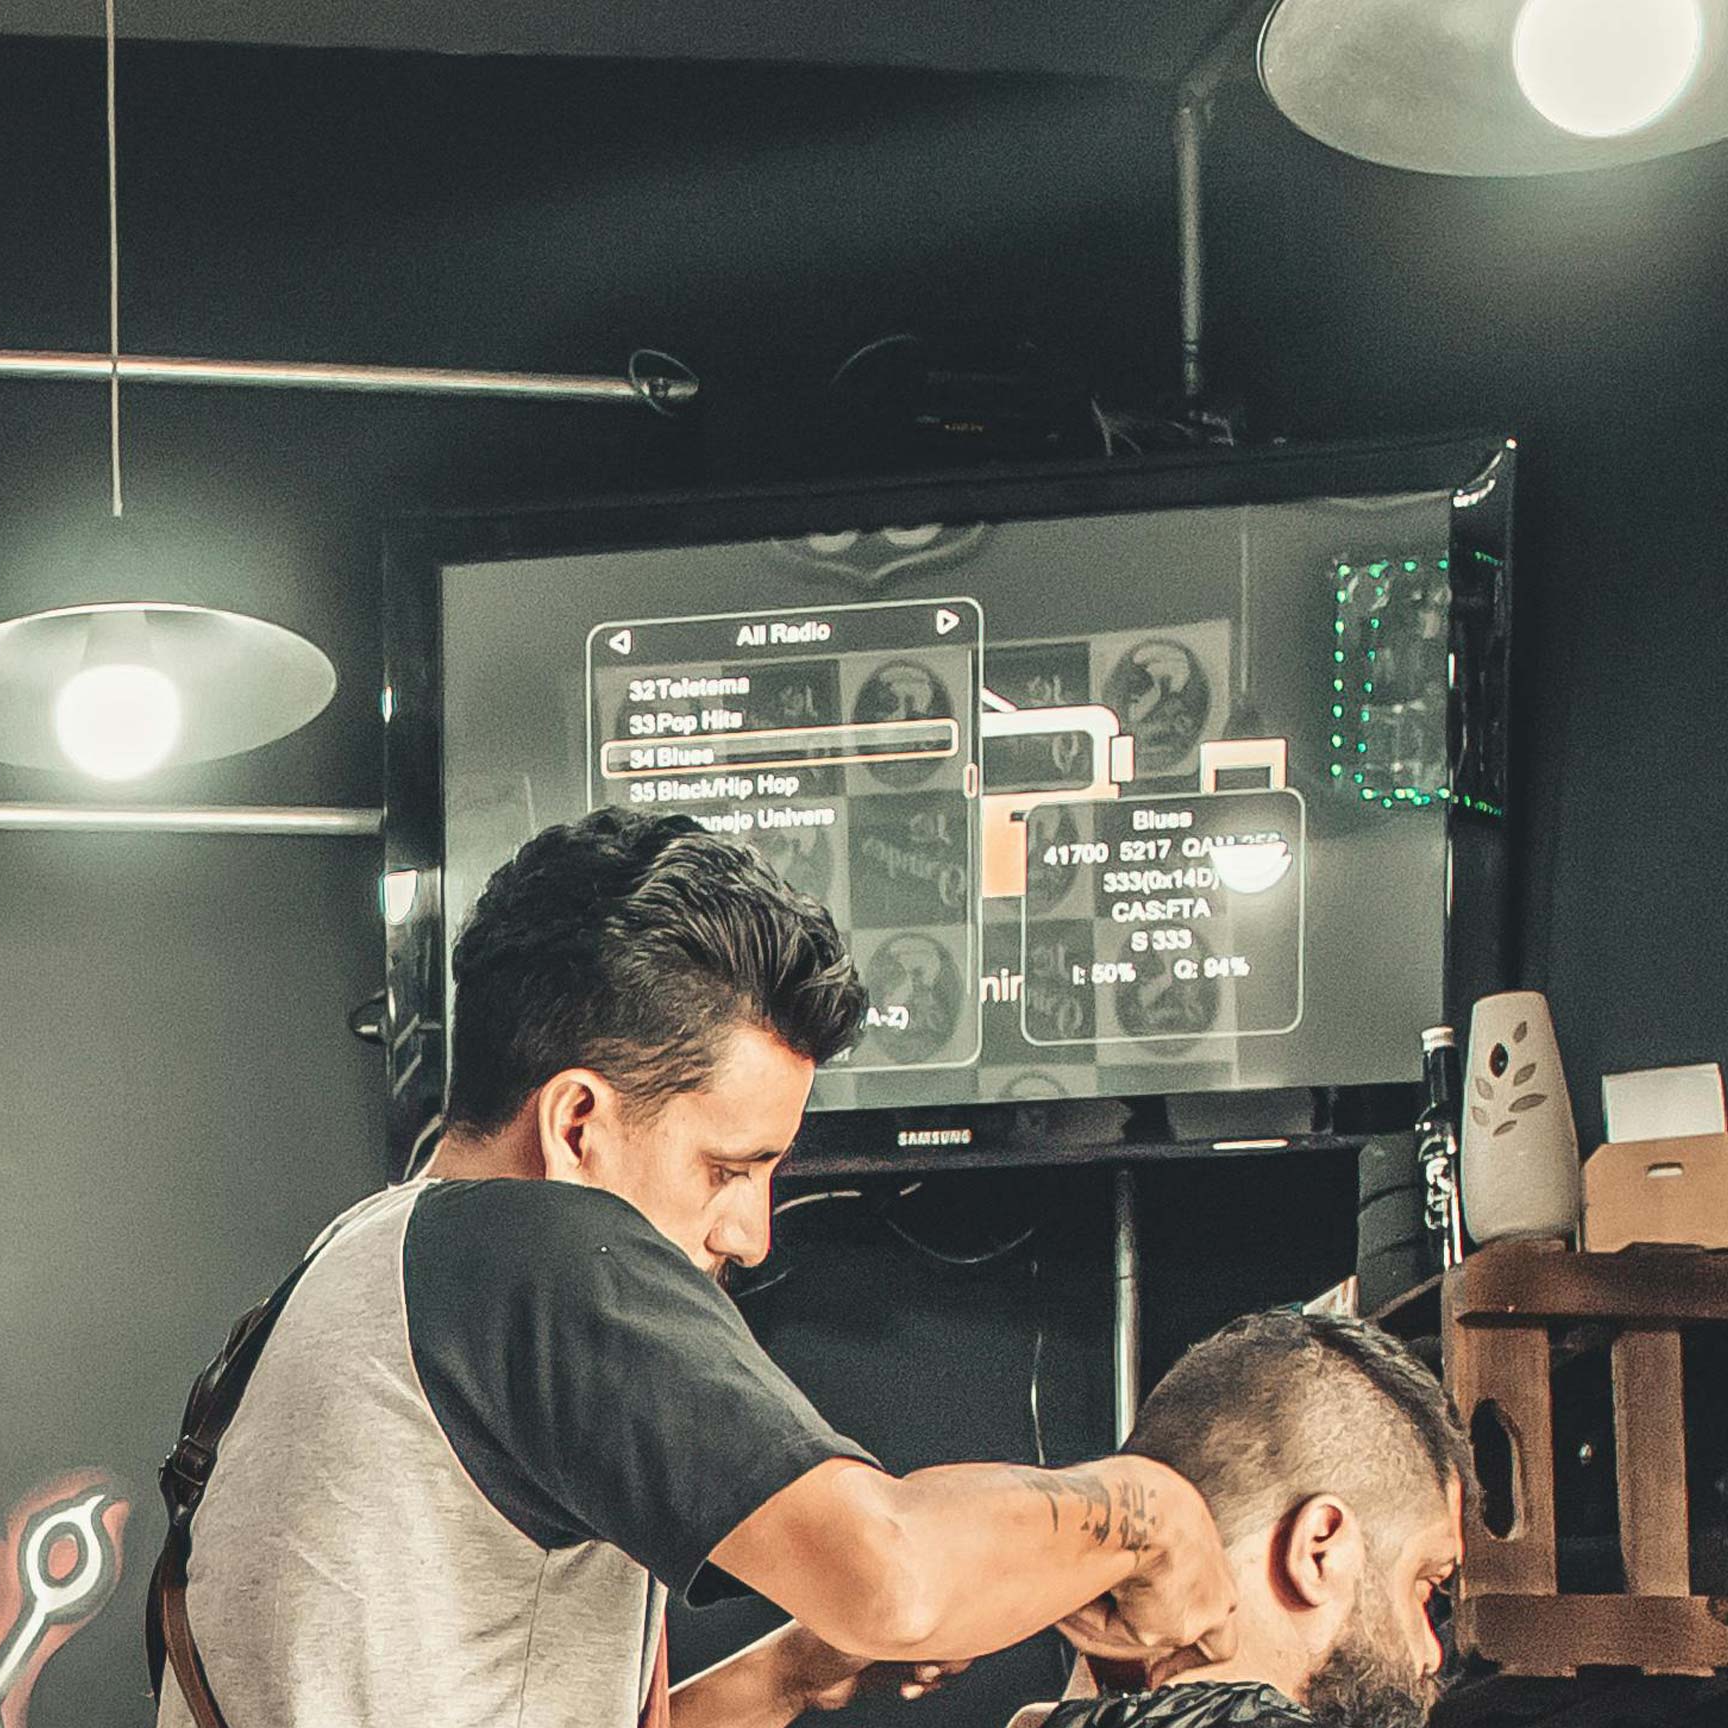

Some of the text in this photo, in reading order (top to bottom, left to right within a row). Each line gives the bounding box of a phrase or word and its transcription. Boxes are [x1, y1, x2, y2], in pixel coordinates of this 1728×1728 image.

[736, 621, 832, 646] All Radio
[629, 680, 656, 701] 32
[629, 709, 743, 735] 33 Pop Hits
[629, 747, 714, 769] 34 Blues
[630, 774, 800, 803] 35 Black/Hip Hop
[691, 808, 835, 834] anejo Univers
[1133, 810, 1193, 830] Blues
[1043, 843, 1109, 866] 41700
[1120, 839, 1172, 862] 5217
[1131, 929, 1193, 951] S 333
[1174, 959, 1198, 980] Q:
[859, 1006, 910, 1030] A-Z)
[897, 1129, 972, 1146] SAMSUNG
